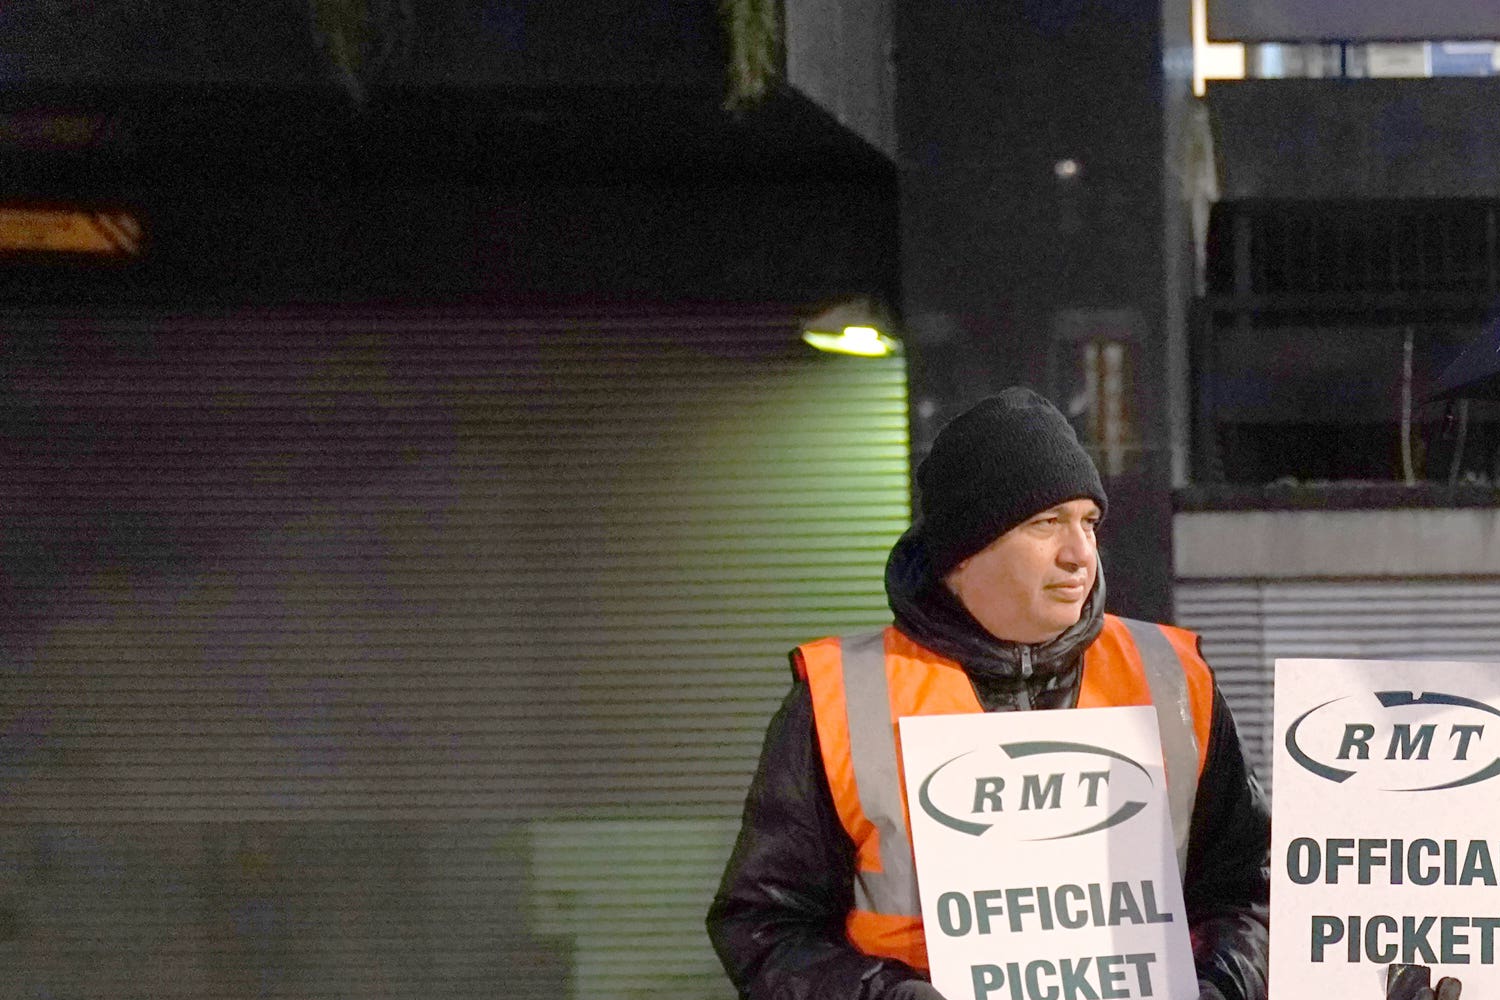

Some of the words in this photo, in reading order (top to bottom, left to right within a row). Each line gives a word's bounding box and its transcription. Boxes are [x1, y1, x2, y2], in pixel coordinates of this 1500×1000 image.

[1337, 722, 1485, 761] RMT
[970, 770, 1110, 814] RMT
[936, 880, 1173, 938] OFFICIAL
